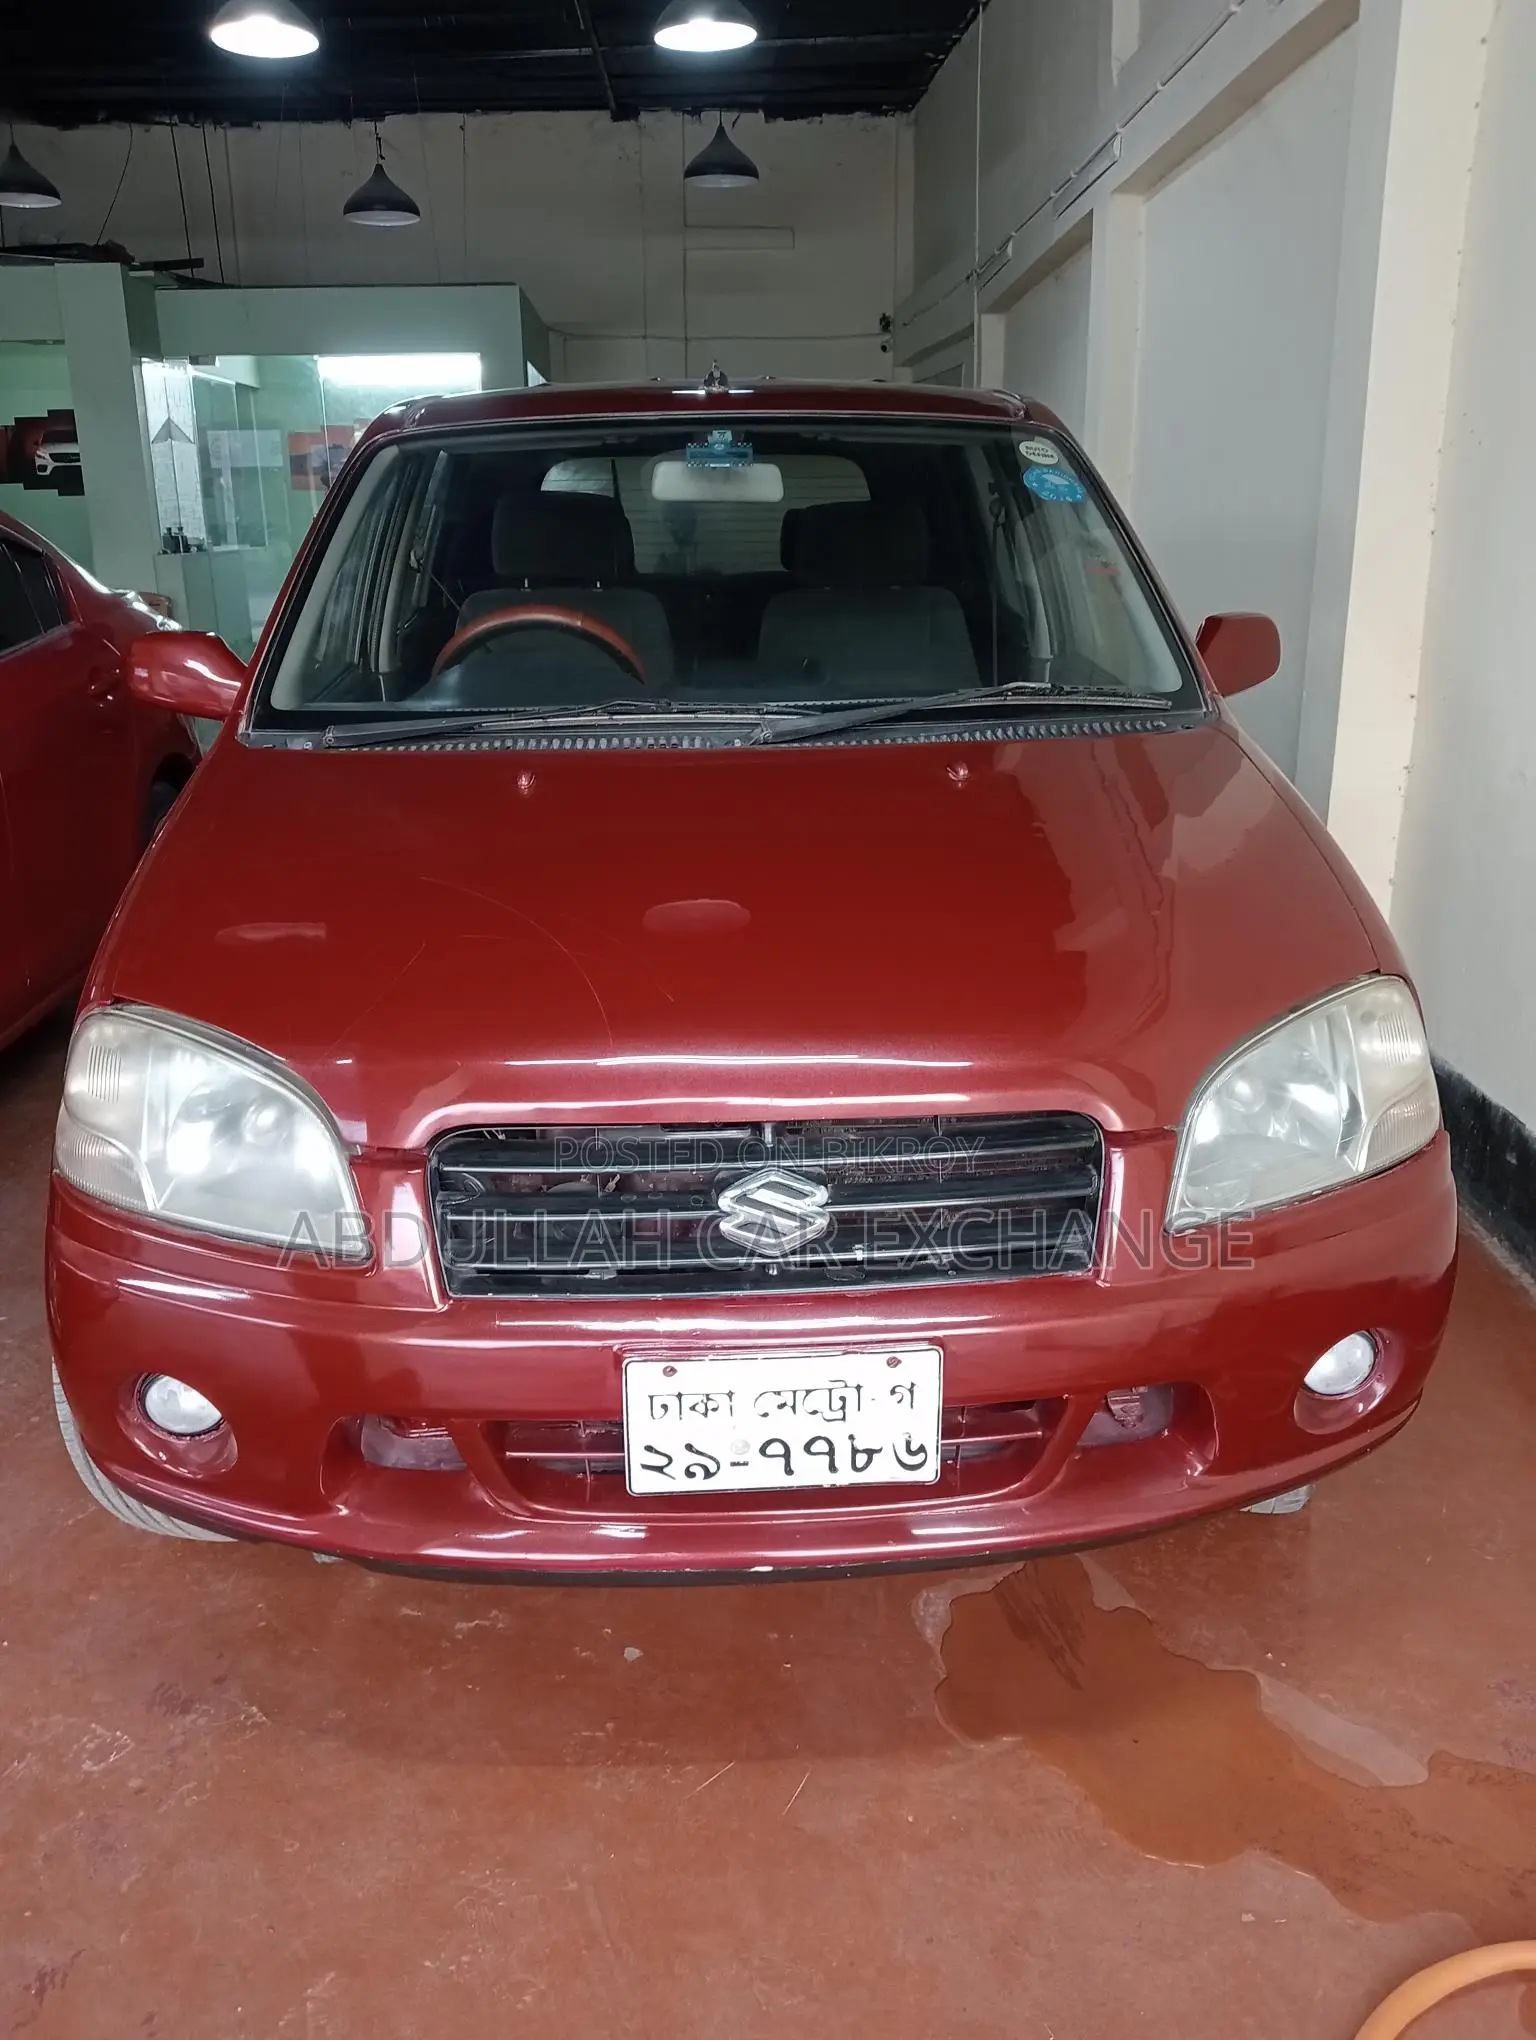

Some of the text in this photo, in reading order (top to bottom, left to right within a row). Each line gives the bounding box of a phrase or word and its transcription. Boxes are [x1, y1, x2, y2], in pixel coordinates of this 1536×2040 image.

[648, 1390, 735, 1420] ঢাকা
[754, 1379, 863, 1422] মেট্রো
[640, 1432, 928, 1480] ২৯-৭৭৮৬
